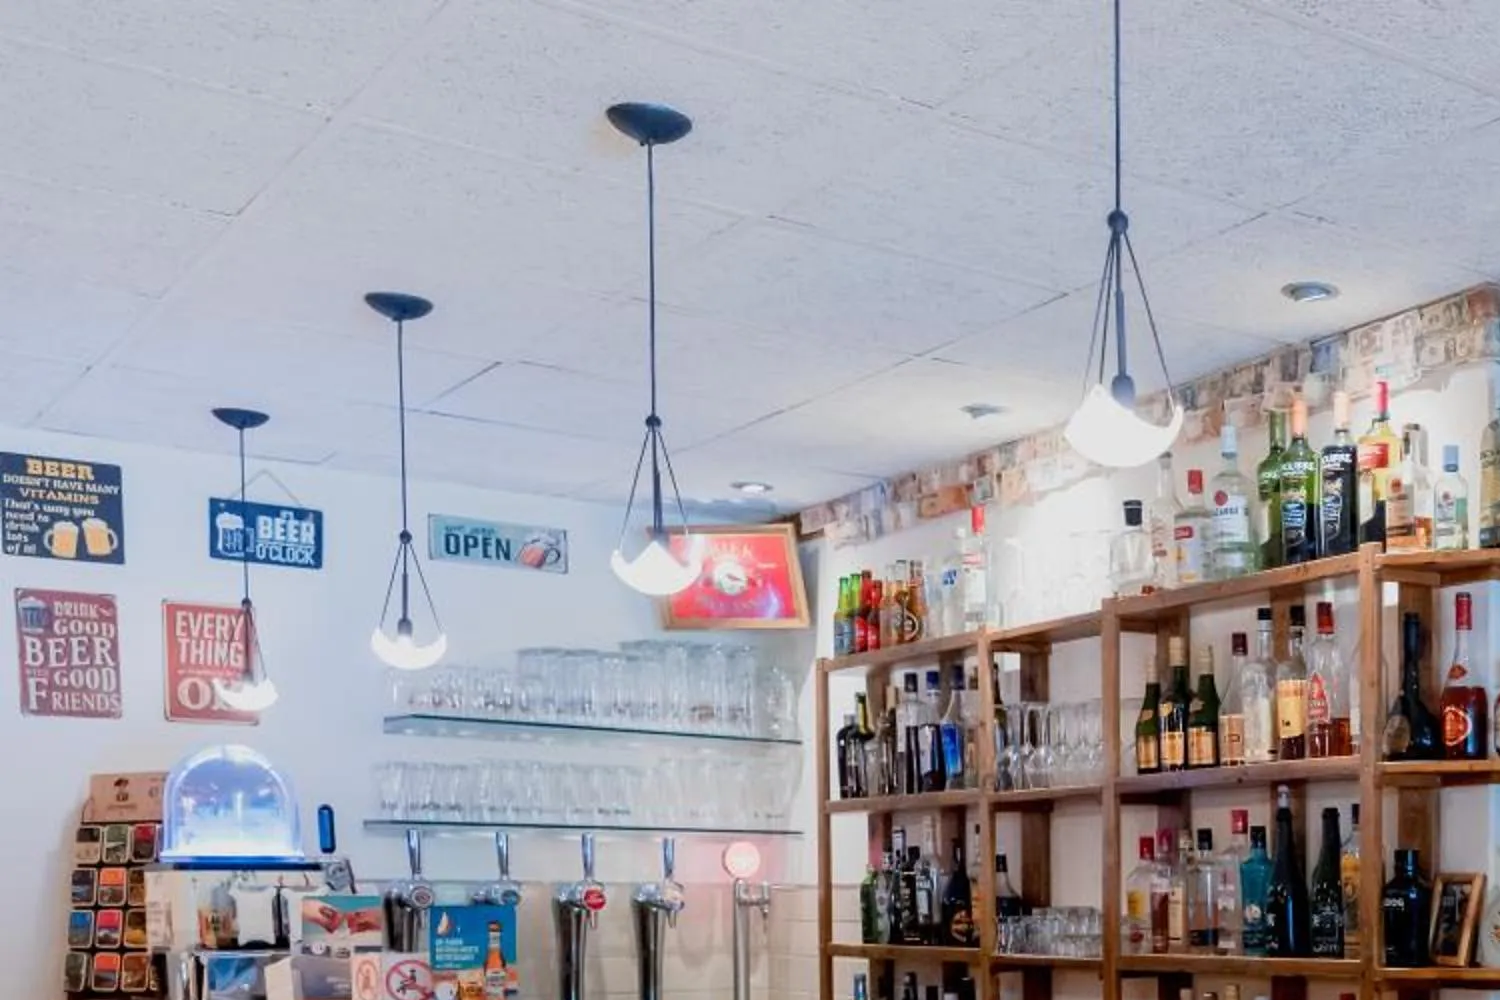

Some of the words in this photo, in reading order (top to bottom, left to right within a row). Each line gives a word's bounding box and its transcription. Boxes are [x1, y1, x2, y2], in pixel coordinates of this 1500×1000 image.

[25, 458, 95, 481] BEER
[19, 486, 100, 505] VITAMINS
[53, 479, 84, 492] HAVE
[85, 482, 120, 496] MANY
[256, 515, 316, 545] BEER
[255, 543, 316, 565] O'CLOCK
[444, 533, 511, 561] OPEN
[53, 601, 100, 618] DRINK
[53, 618, 115, 638] GOOD
[175, 611, 245, 641] EVERY
[23, 636, 117, 668] BEER
[177, 638, 244, 669] THING
[53, 667, 117, 693] GOOD
